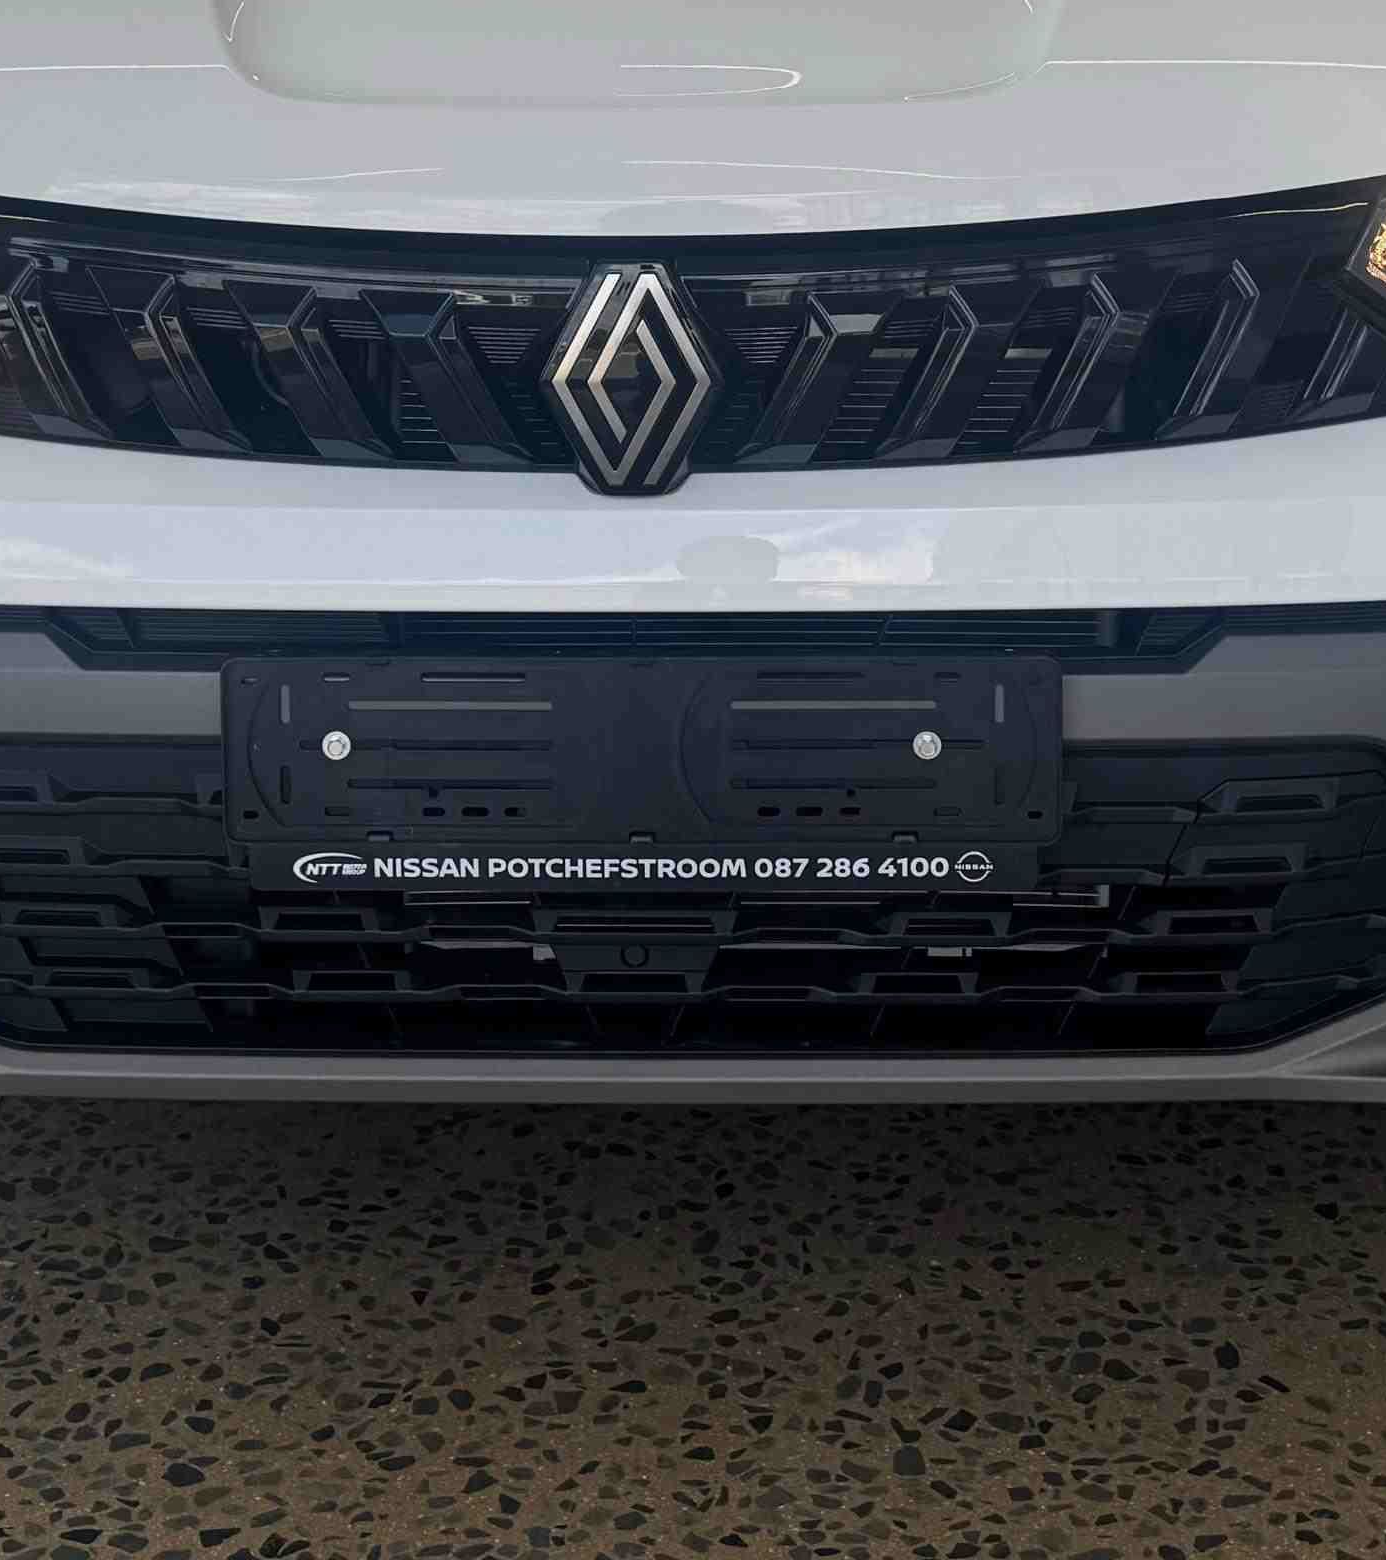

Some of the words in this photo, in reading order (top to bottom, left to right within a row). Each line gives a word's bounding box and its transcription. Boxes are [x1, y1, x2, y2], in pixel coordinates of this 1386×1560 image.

[305, 862, 343, 876] NTT
[373, 858, 480, 879] NISSAN
[488, 857, 747, 879] POTCHEFSTROOM
[754, 857, 810, 879] 087
[816, 857, 870, 879] 286
[878, 857, 949, 879] 4100
[954, 863, 994, 871] NISSAN
